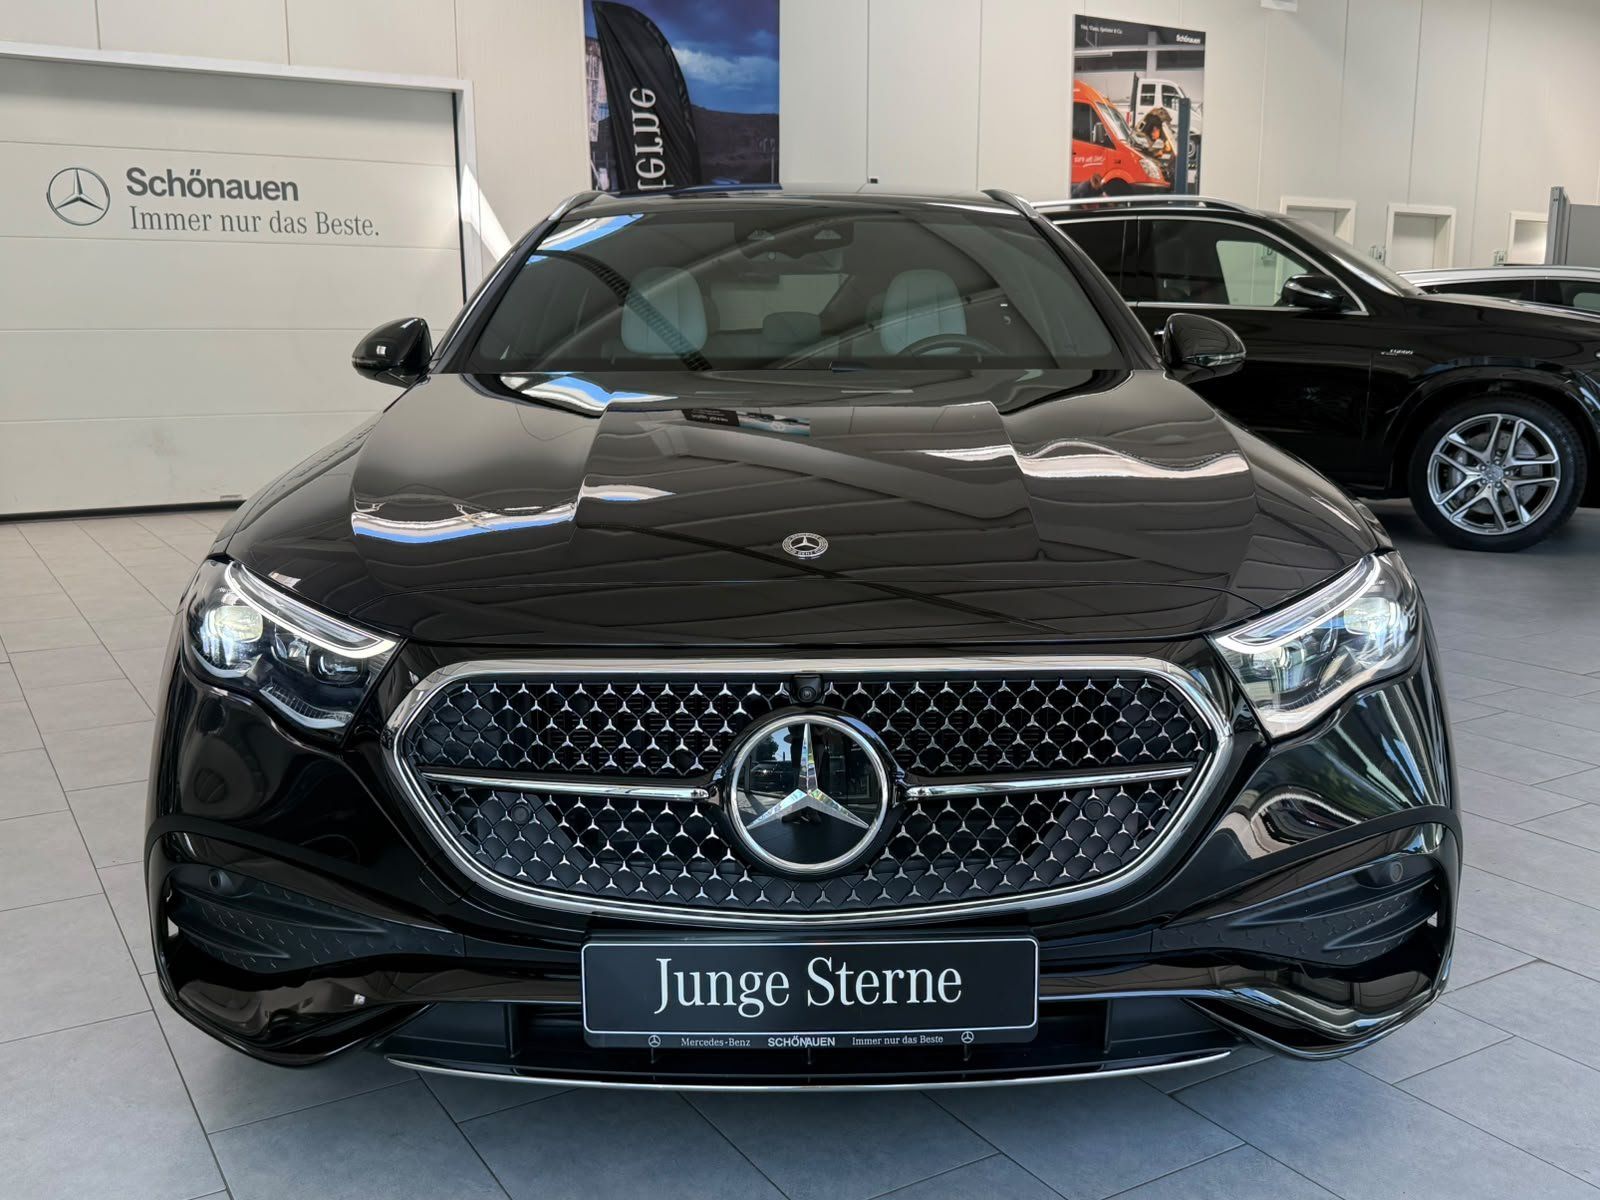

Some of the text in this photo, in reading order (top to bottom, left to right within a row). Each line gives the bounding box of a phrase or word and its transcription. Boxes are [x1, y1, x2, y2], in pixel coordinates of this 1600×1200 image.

[126, 166, 299, 202] Schönauen
[129, 205, 380, 237] Immer nur das Beste.
[653, 956, 962, 1018] Junge Sterne
[681, 1034, 944, 1048] Mercedes-Benz SCHÖNAUEN Immer nur das Beste
